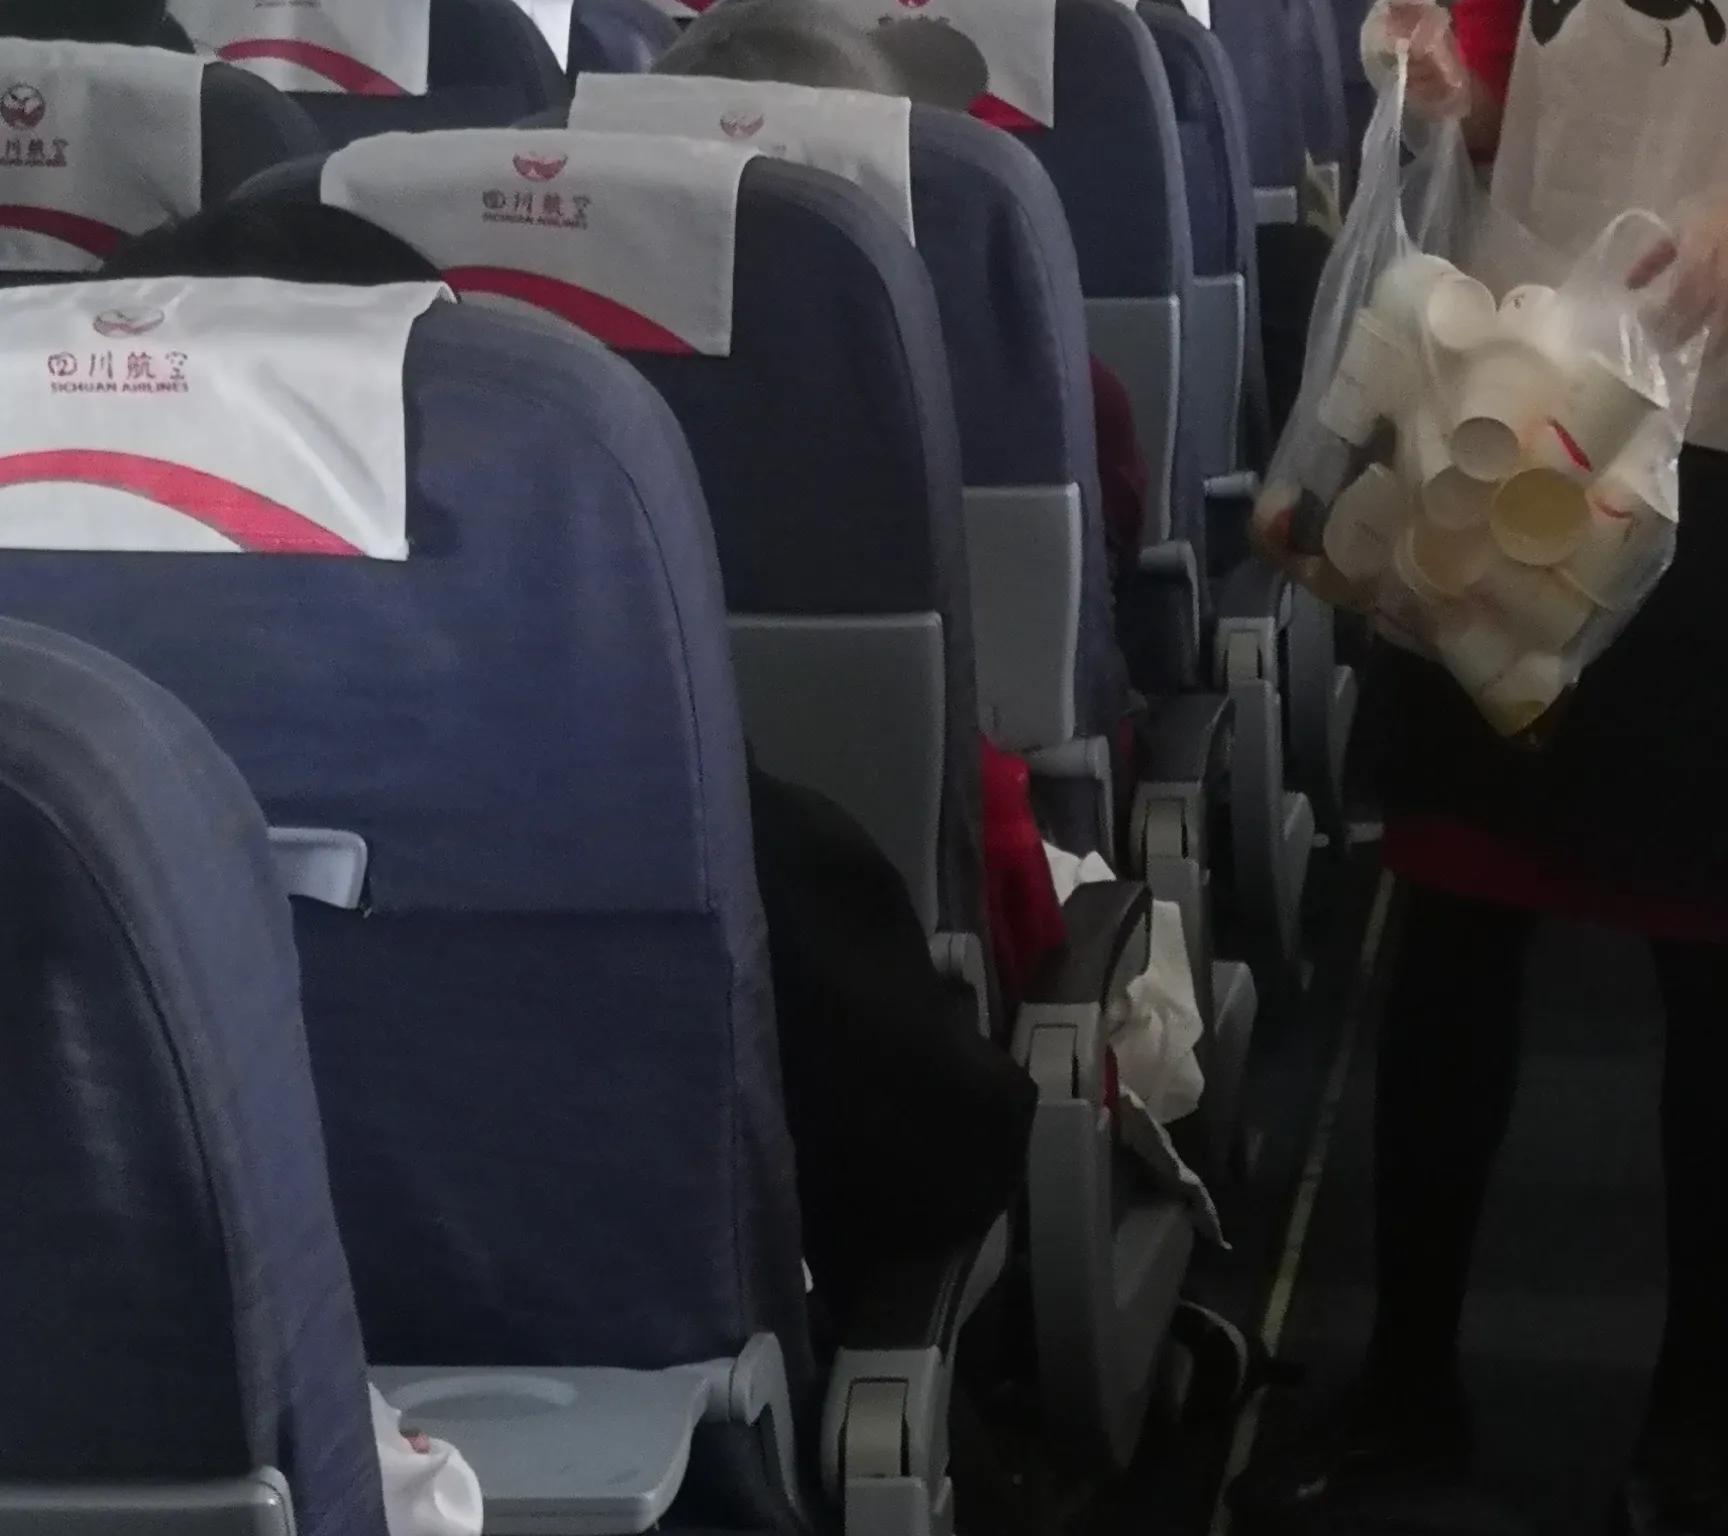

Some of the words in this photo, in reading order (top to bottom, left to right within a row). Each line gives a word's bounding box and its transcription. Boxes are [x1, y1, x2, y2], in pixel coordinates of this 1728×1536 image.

[48, 351, 188, 380] 四川航空
[50, 381, 117, 393] SICHUAN
[121, 381, 189, 393] AIRLINES
